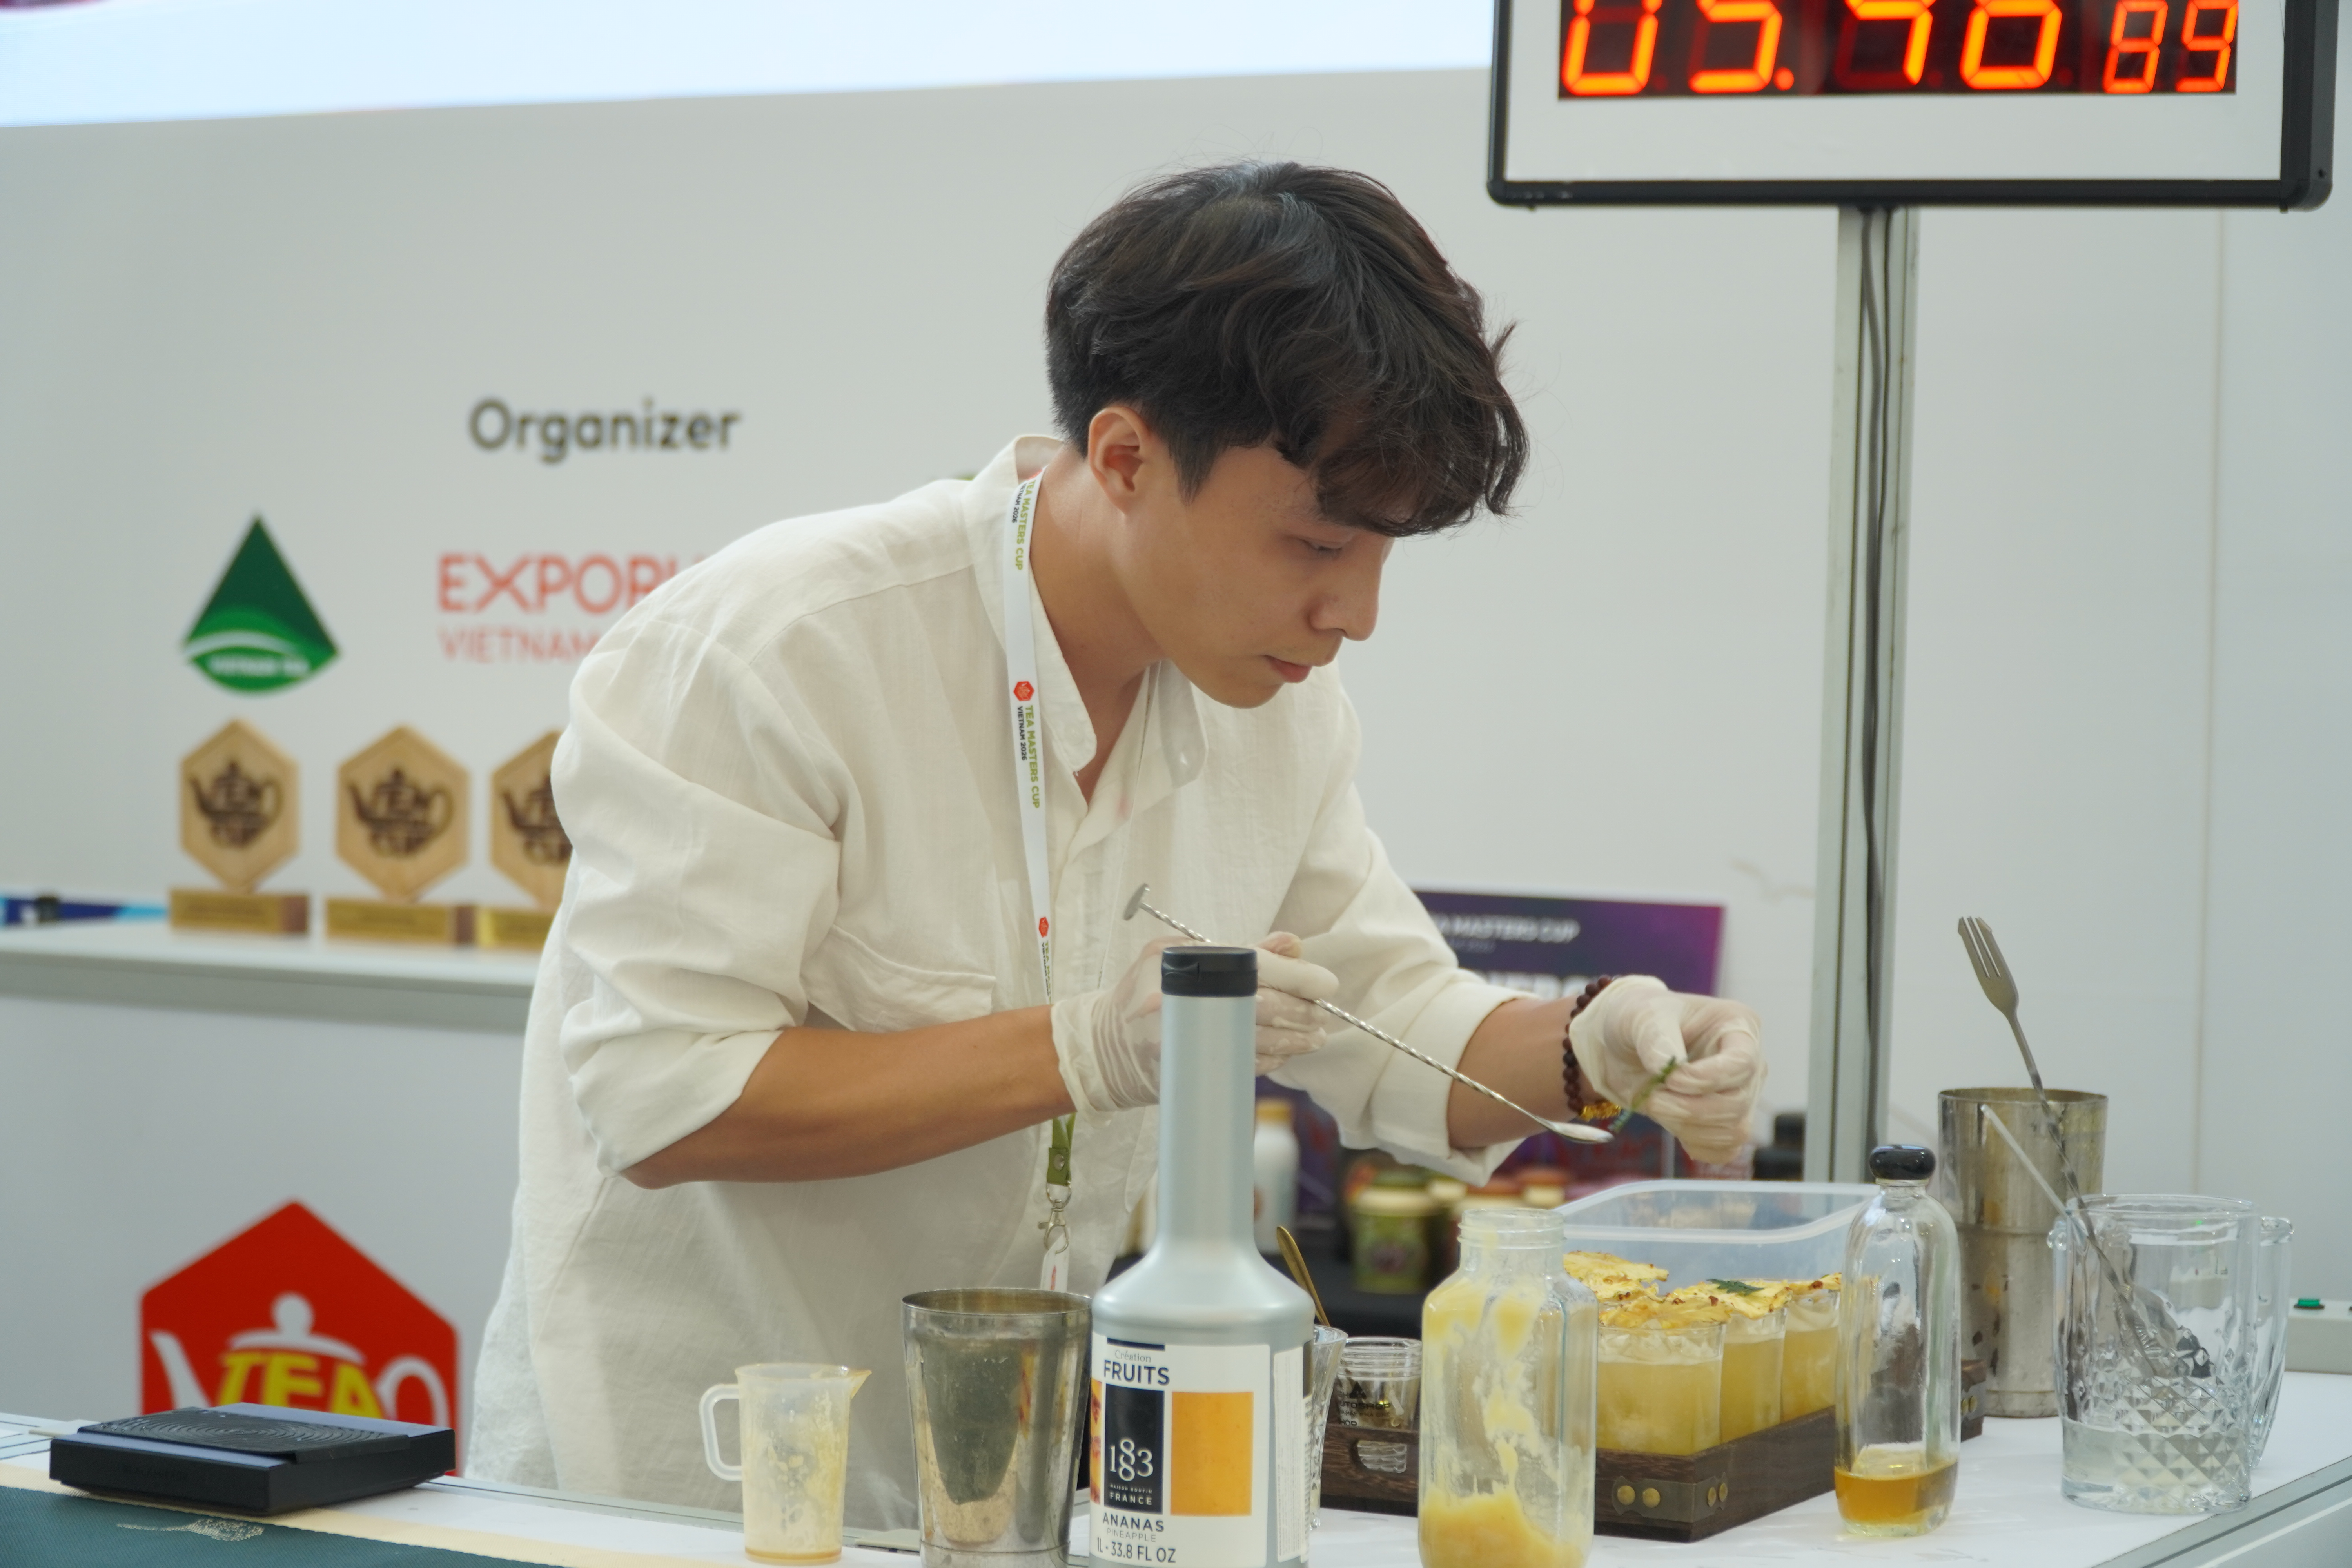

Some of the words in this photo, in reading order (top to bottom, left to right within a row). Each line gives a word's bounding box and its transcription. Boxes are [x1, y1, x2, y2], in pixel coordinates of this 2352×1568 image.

[469, 397, 740, 466] Organizer
[1015, 483, 1027, 505] VIETNAM
[1024, 479, 1036, 496] TEA
[1017, 498, 1031, 544] MASTERS
[1015, 548, 1024, 570] CUP
[436, 552, 710, 615] EXPOR
[1025, 705, 1035, 728] TEA
[1027, 730, 1038, 783] MASTERS
[1031, 786, 1040, 808] CUP
[1115, 1350, 1151, 1363] Création
[1104, 1359, 1170, 1386] FRUITS
[218, 1350, 385, 1420] TEA
[1110, 1492, 1152, 1505] FRANCE
[1103, 1512, 1164, 1532] ANANAS
[1107, 1528, 1156, 1543] PINEAPPLE
[1097, 1537, 1103, 1553] 1L
[1111, 1541, 1133, 1559] 33.8
[1138, 1545, 1152, 1561] FL
[1156, 1547, 1176, 1563] OZ
